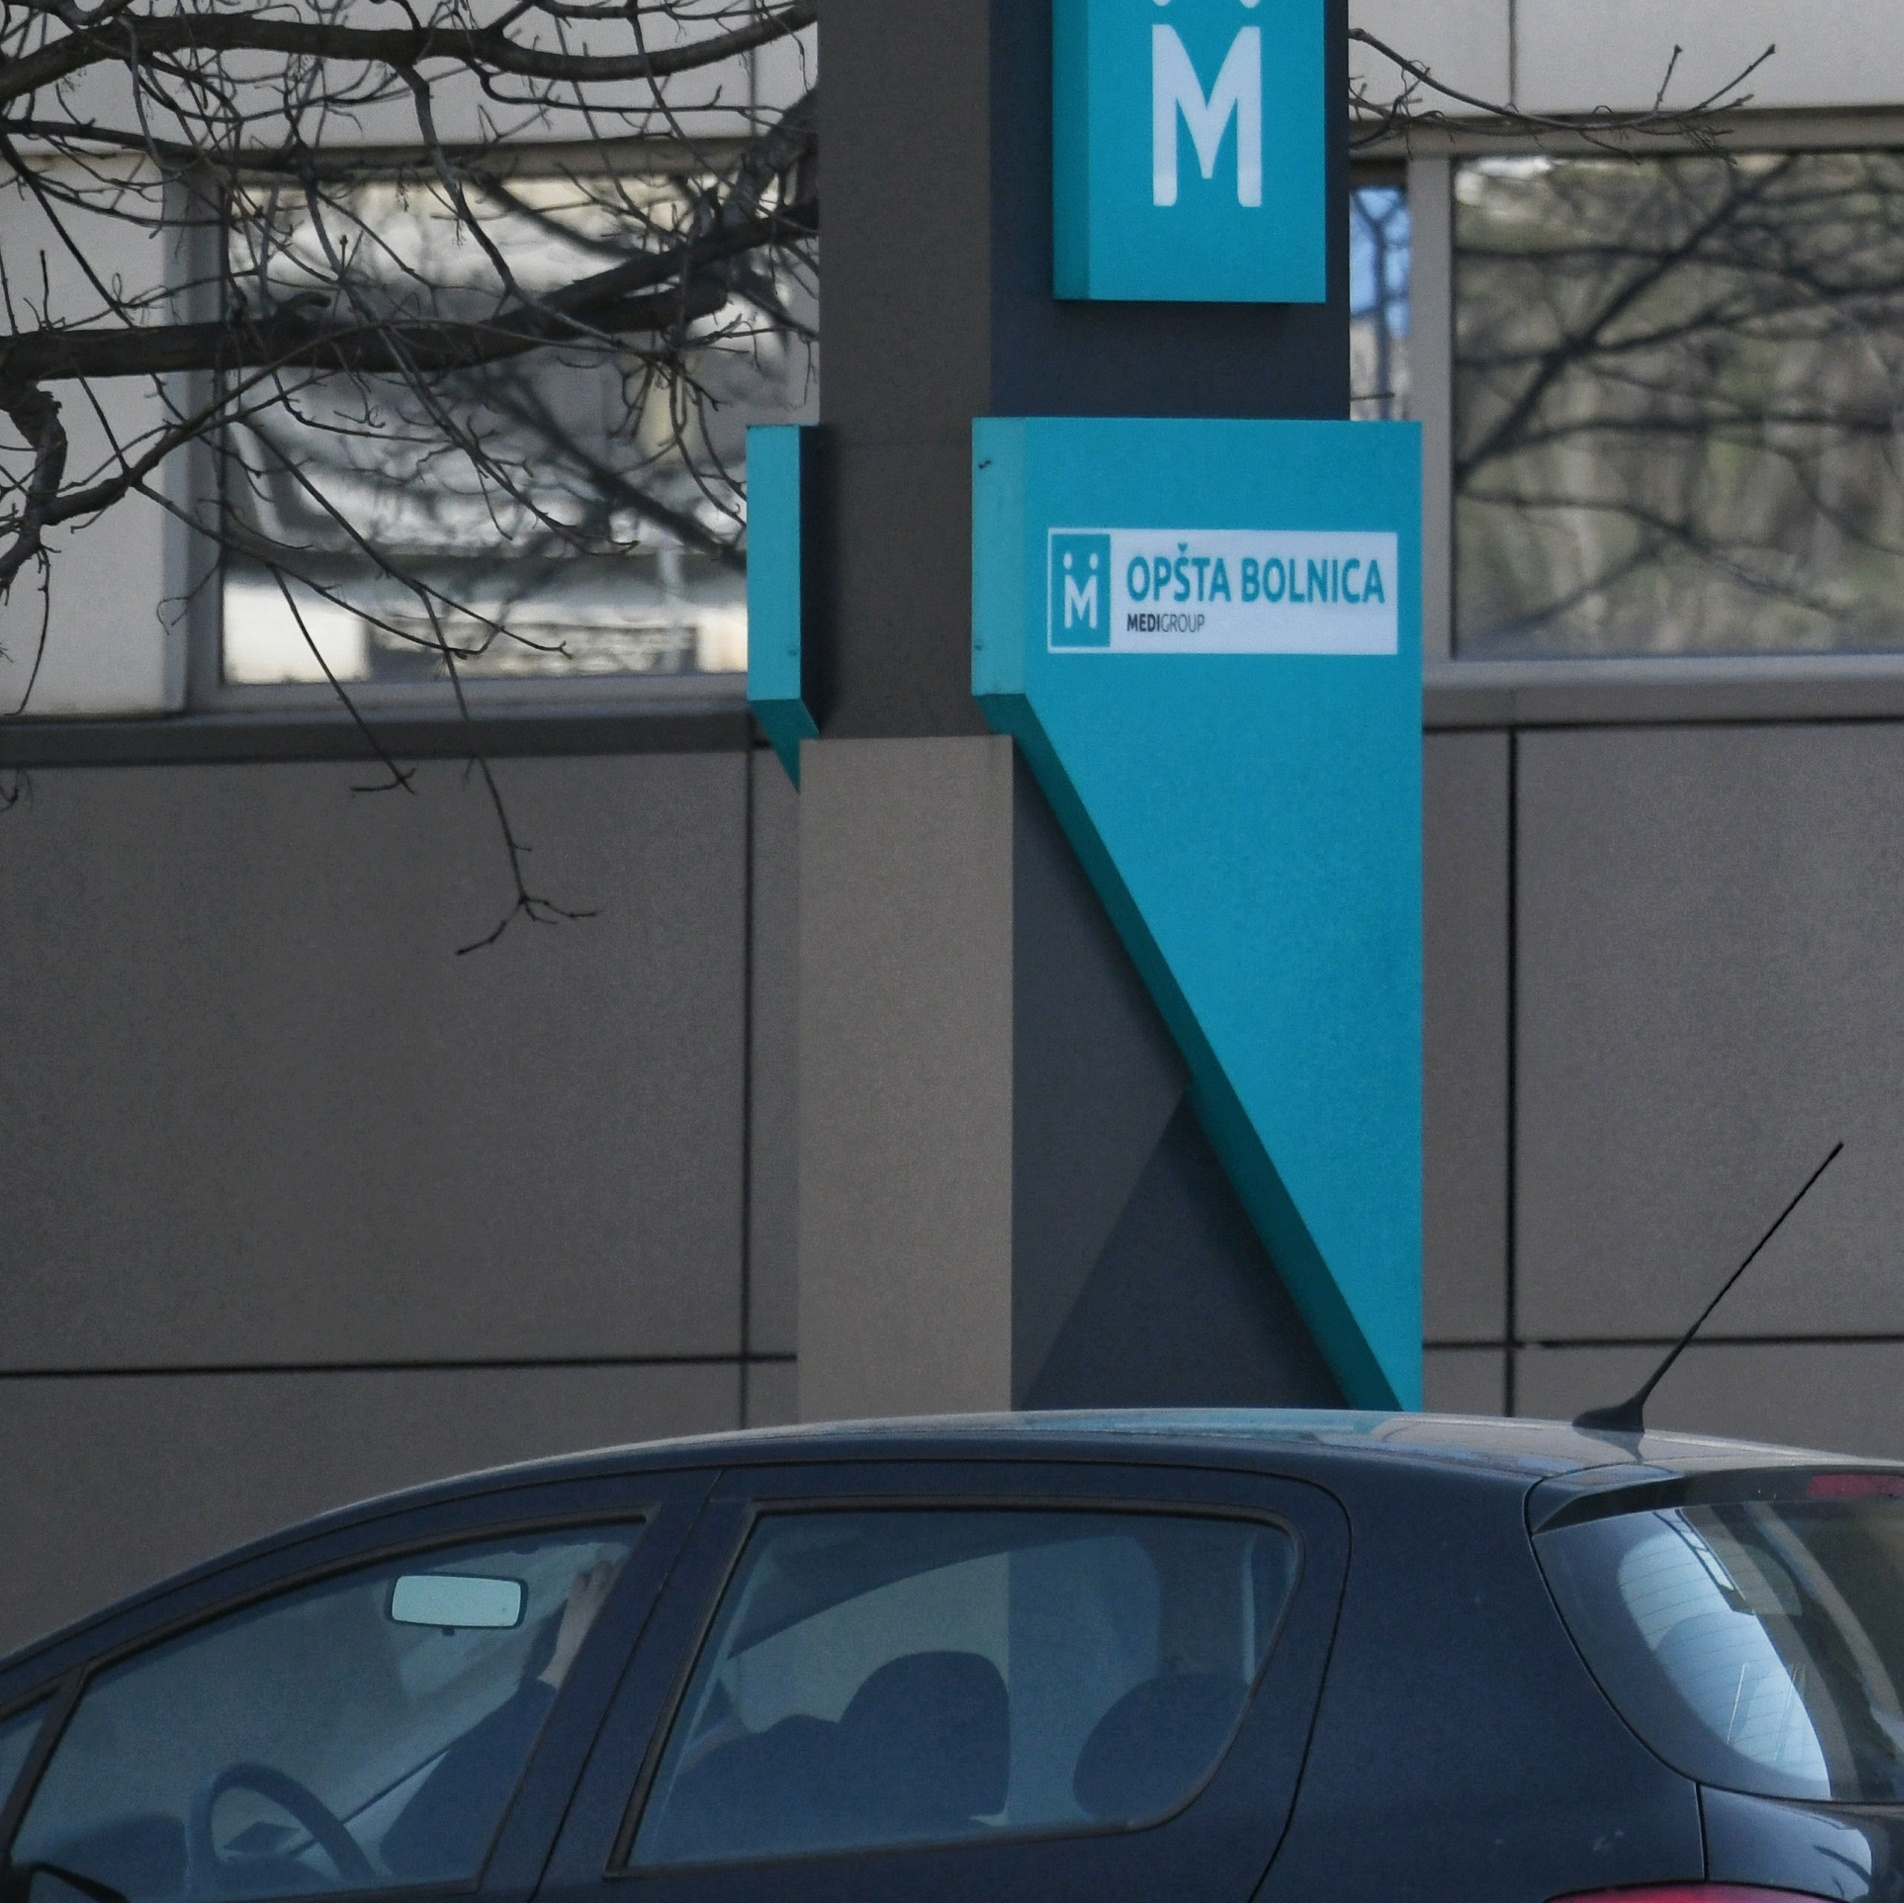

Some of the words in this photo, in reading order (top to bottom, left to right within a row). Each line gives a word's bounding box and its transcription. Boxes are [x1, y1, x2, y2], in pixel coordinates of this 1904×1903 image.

[1150, 22, 1263, 208] M
[1063, 573, 1099, 629] M
[1126, 542, 1232, 602] OPŠTA
[1240, 557, 1385, 604] BOLNICA
[1126, 612, 1205, 633] MEDIGROUP
